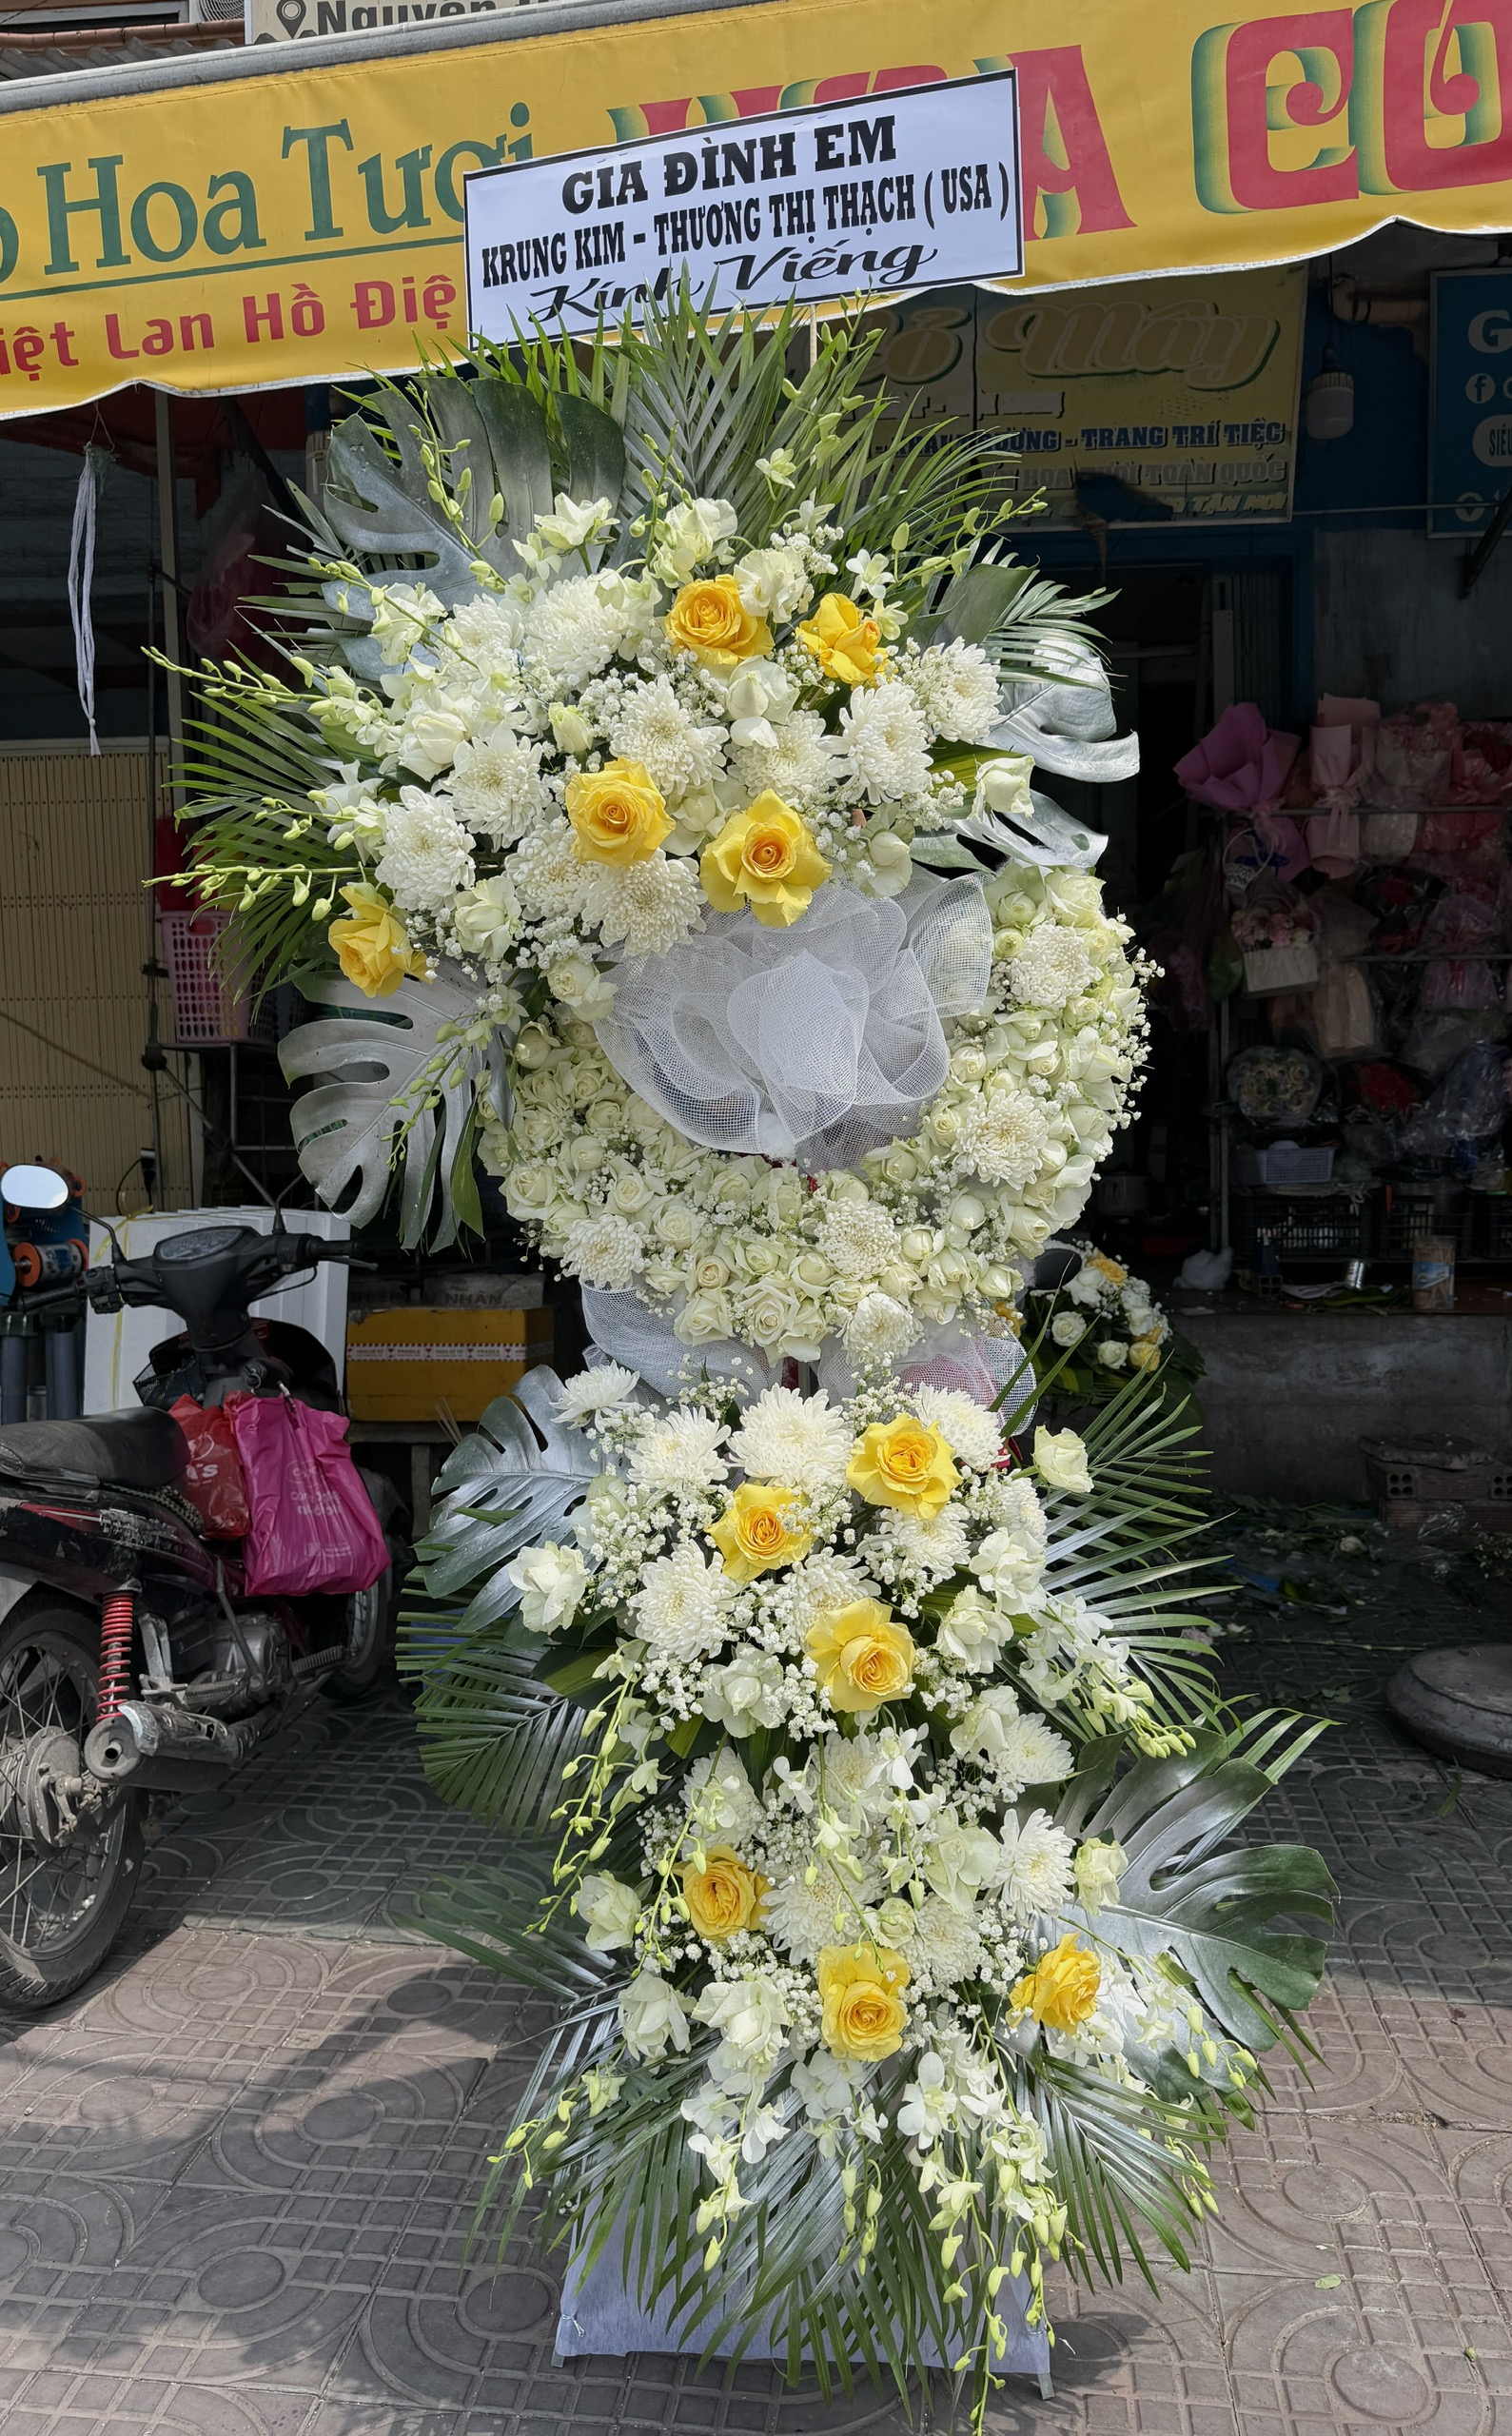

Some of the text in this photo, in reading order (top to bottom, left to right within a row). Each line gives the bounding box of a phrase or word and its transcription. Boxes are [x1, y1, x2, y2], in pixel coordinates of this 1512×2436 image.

[562, 115, 896, 215] GIA ĐÌNH EM
[37, 154, 267, 275] Hoa
[481, 232, 567, 288] KRUNG
[575, 222, 625, 270] KIM
[654, 197, 761, 256] THƯƠNG
[769, 188, 815, 244] THỊ
[823, 174, 915, 236] THẠCH
[105, 313, 215, 360] Lan
[243, 283, 326, 344] Hồ
[528, 239, 938, 321] Kính Viếng
[984, 300, 1282, 392] Mây
[1081, 426, 1168, 450] TRANG
[1172, 420, 1221, 448] TRÍ
[1224, 418, 1286, 450] TIỆC
[1219, 453, 1287, 486] QUỐC
